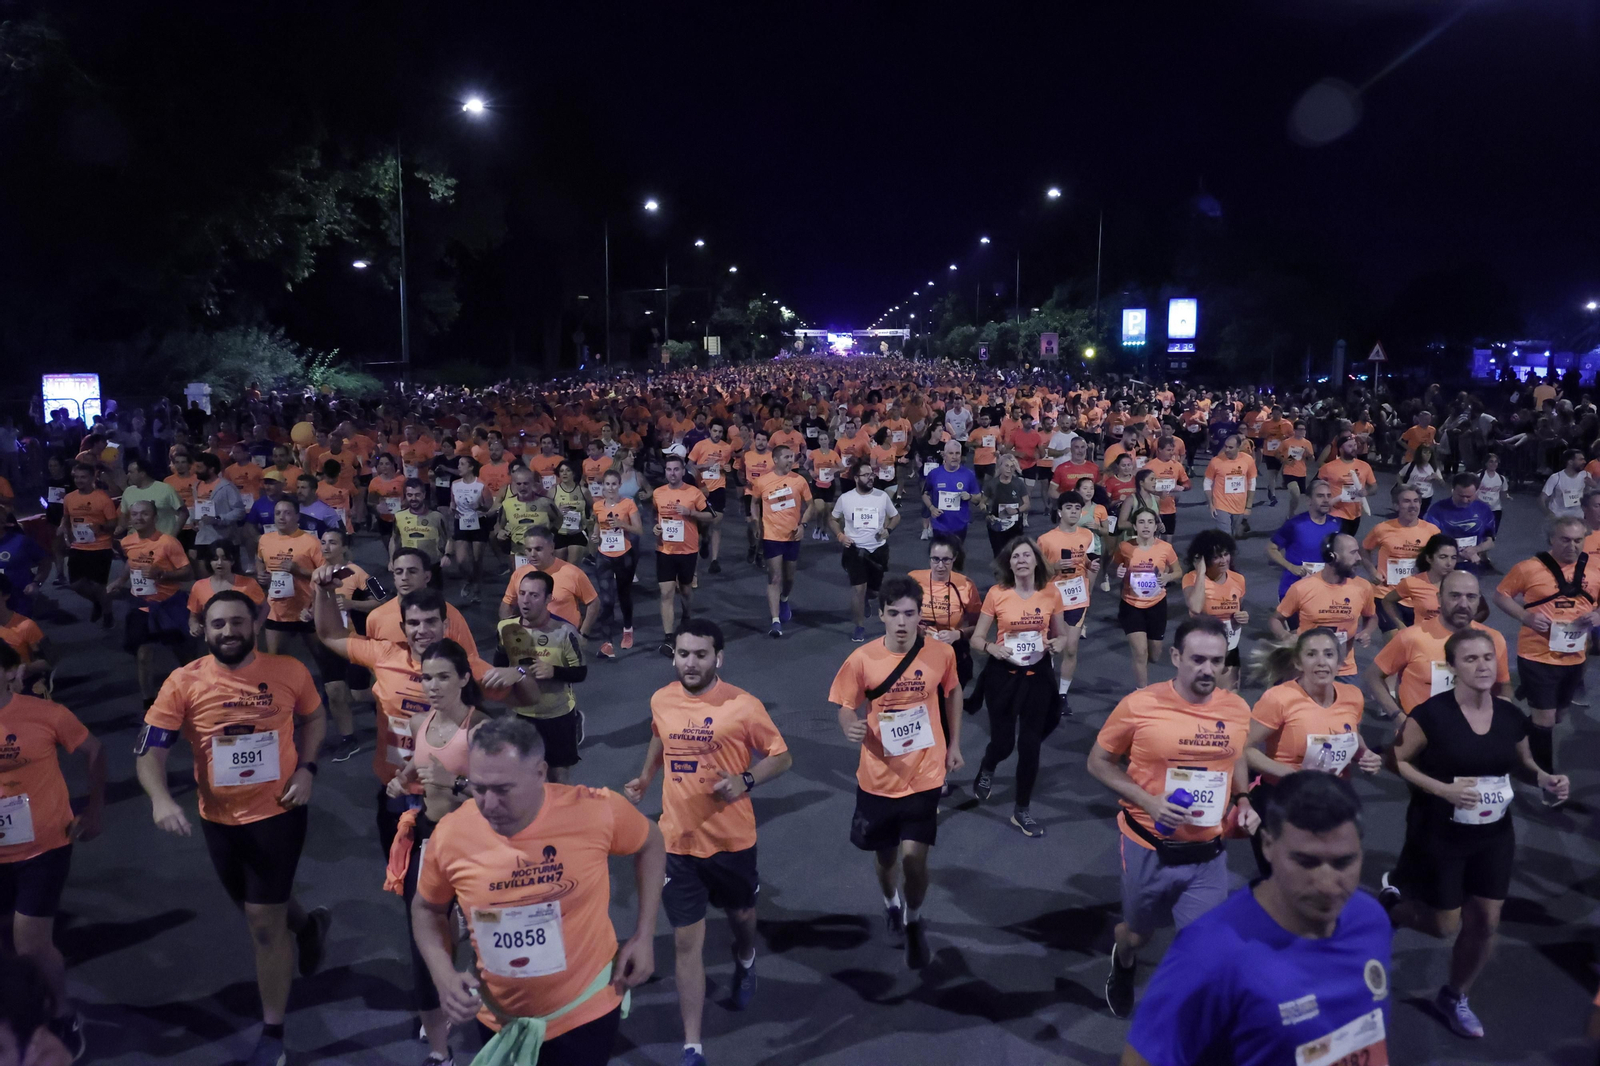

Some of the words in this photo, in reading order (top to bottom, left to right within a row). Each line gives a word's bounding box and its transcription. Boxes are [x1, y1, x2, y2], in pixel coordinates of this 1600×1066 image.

[1395, 567, 1415, 575] 19870
[1137, 581, 1157, 590] 10023
[1063, 586, 1083, 596] 10913
[1016, 642, 1036, 652] 5979
[256, 699, 273, 708] KH7
[682, 728, 714, 736] NOCTURNA
[891, 720, 922, 738] 10974
[669, 733, 695, 741] SEVILLA
[1178, 739, 1211, 748] SEVILLA
[1211, 740, 1230, 749] KH7
[232, 750, 263, 765] 8591
[511, 862, 564, 879] NOCTURNA
[488, 878, 535, 893] SEVILLA
[537, 870, 564, 885] KH7
[493, 928, 546, 949] 20858
